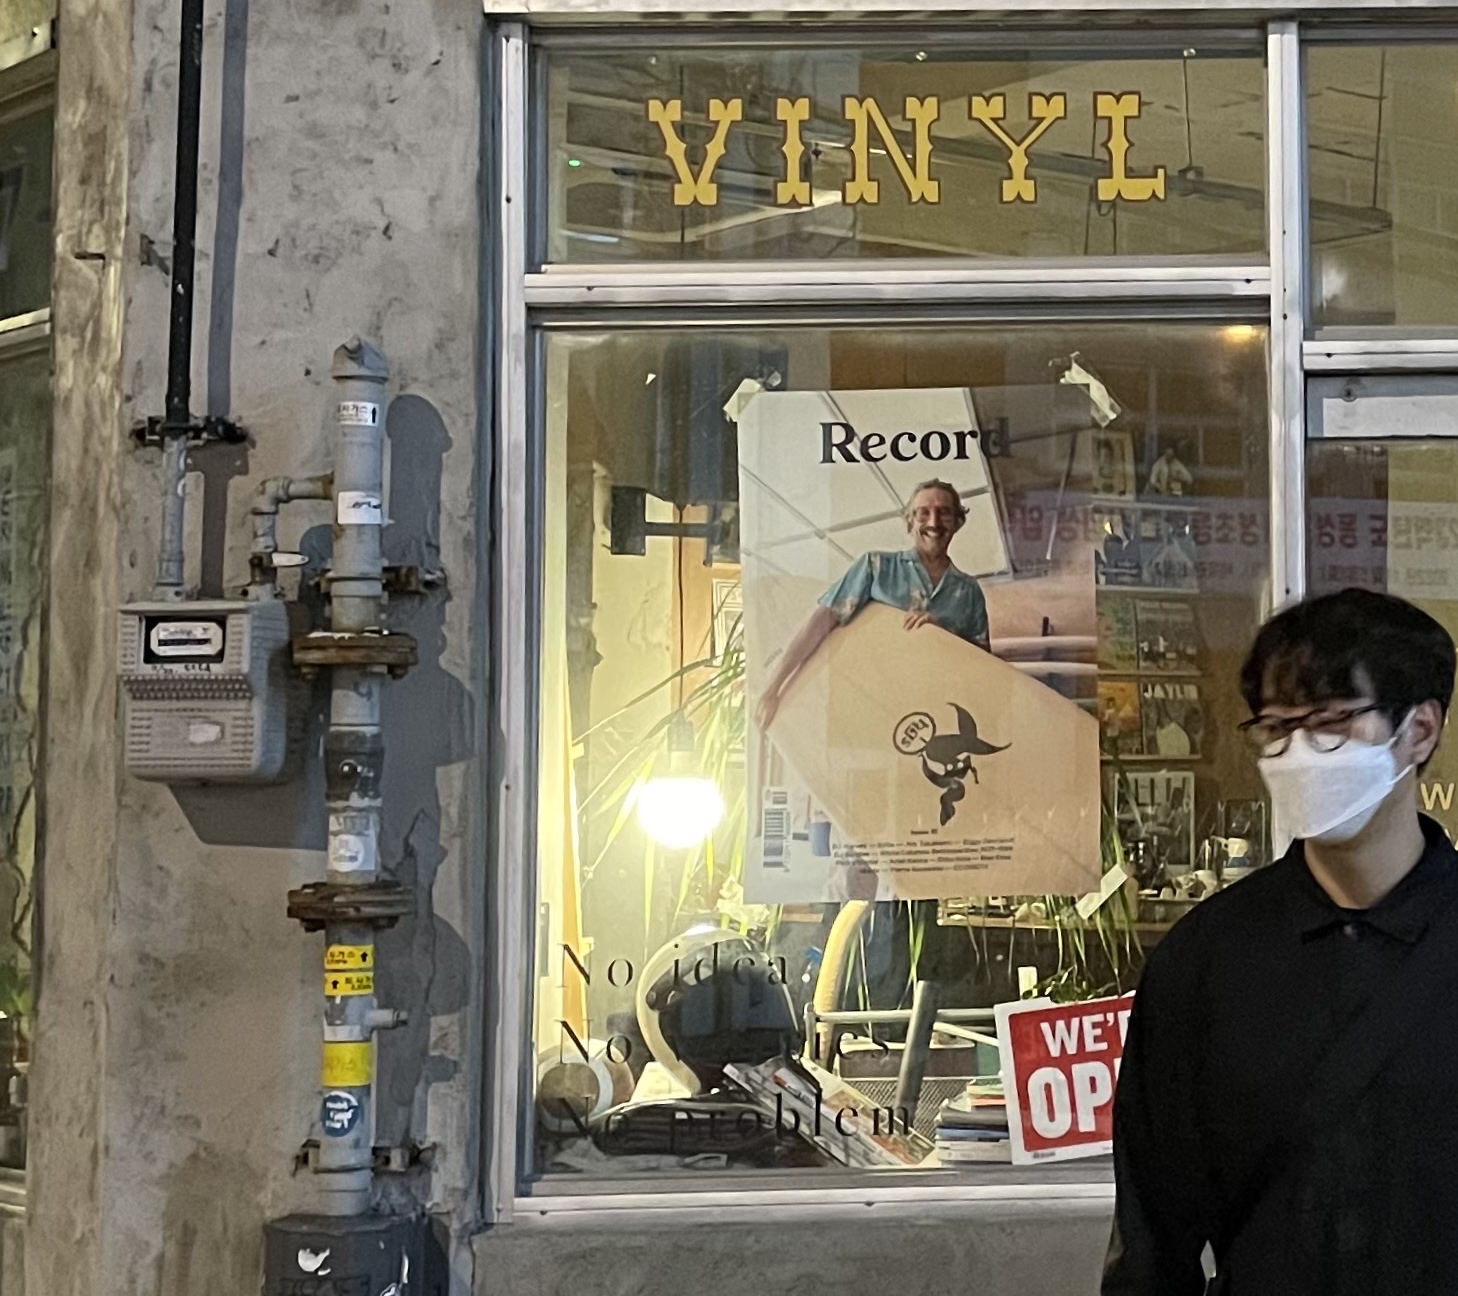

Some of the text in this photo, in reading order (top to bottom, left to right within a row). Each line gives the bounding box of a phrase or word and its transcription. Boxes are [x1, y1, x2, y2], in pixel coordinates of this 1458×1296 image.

[647, 92, 1166, 207] VINYL
[819, 416, 1014, 465] Record
[556, 941, 789, 989] No idea
[555, 1019, 633, 1064] No
[1040, 1009, 1132, 1058] WE'
[556, 1089, 914, 1152] No problem
[1027, 1057, 1123, 1139] OP
